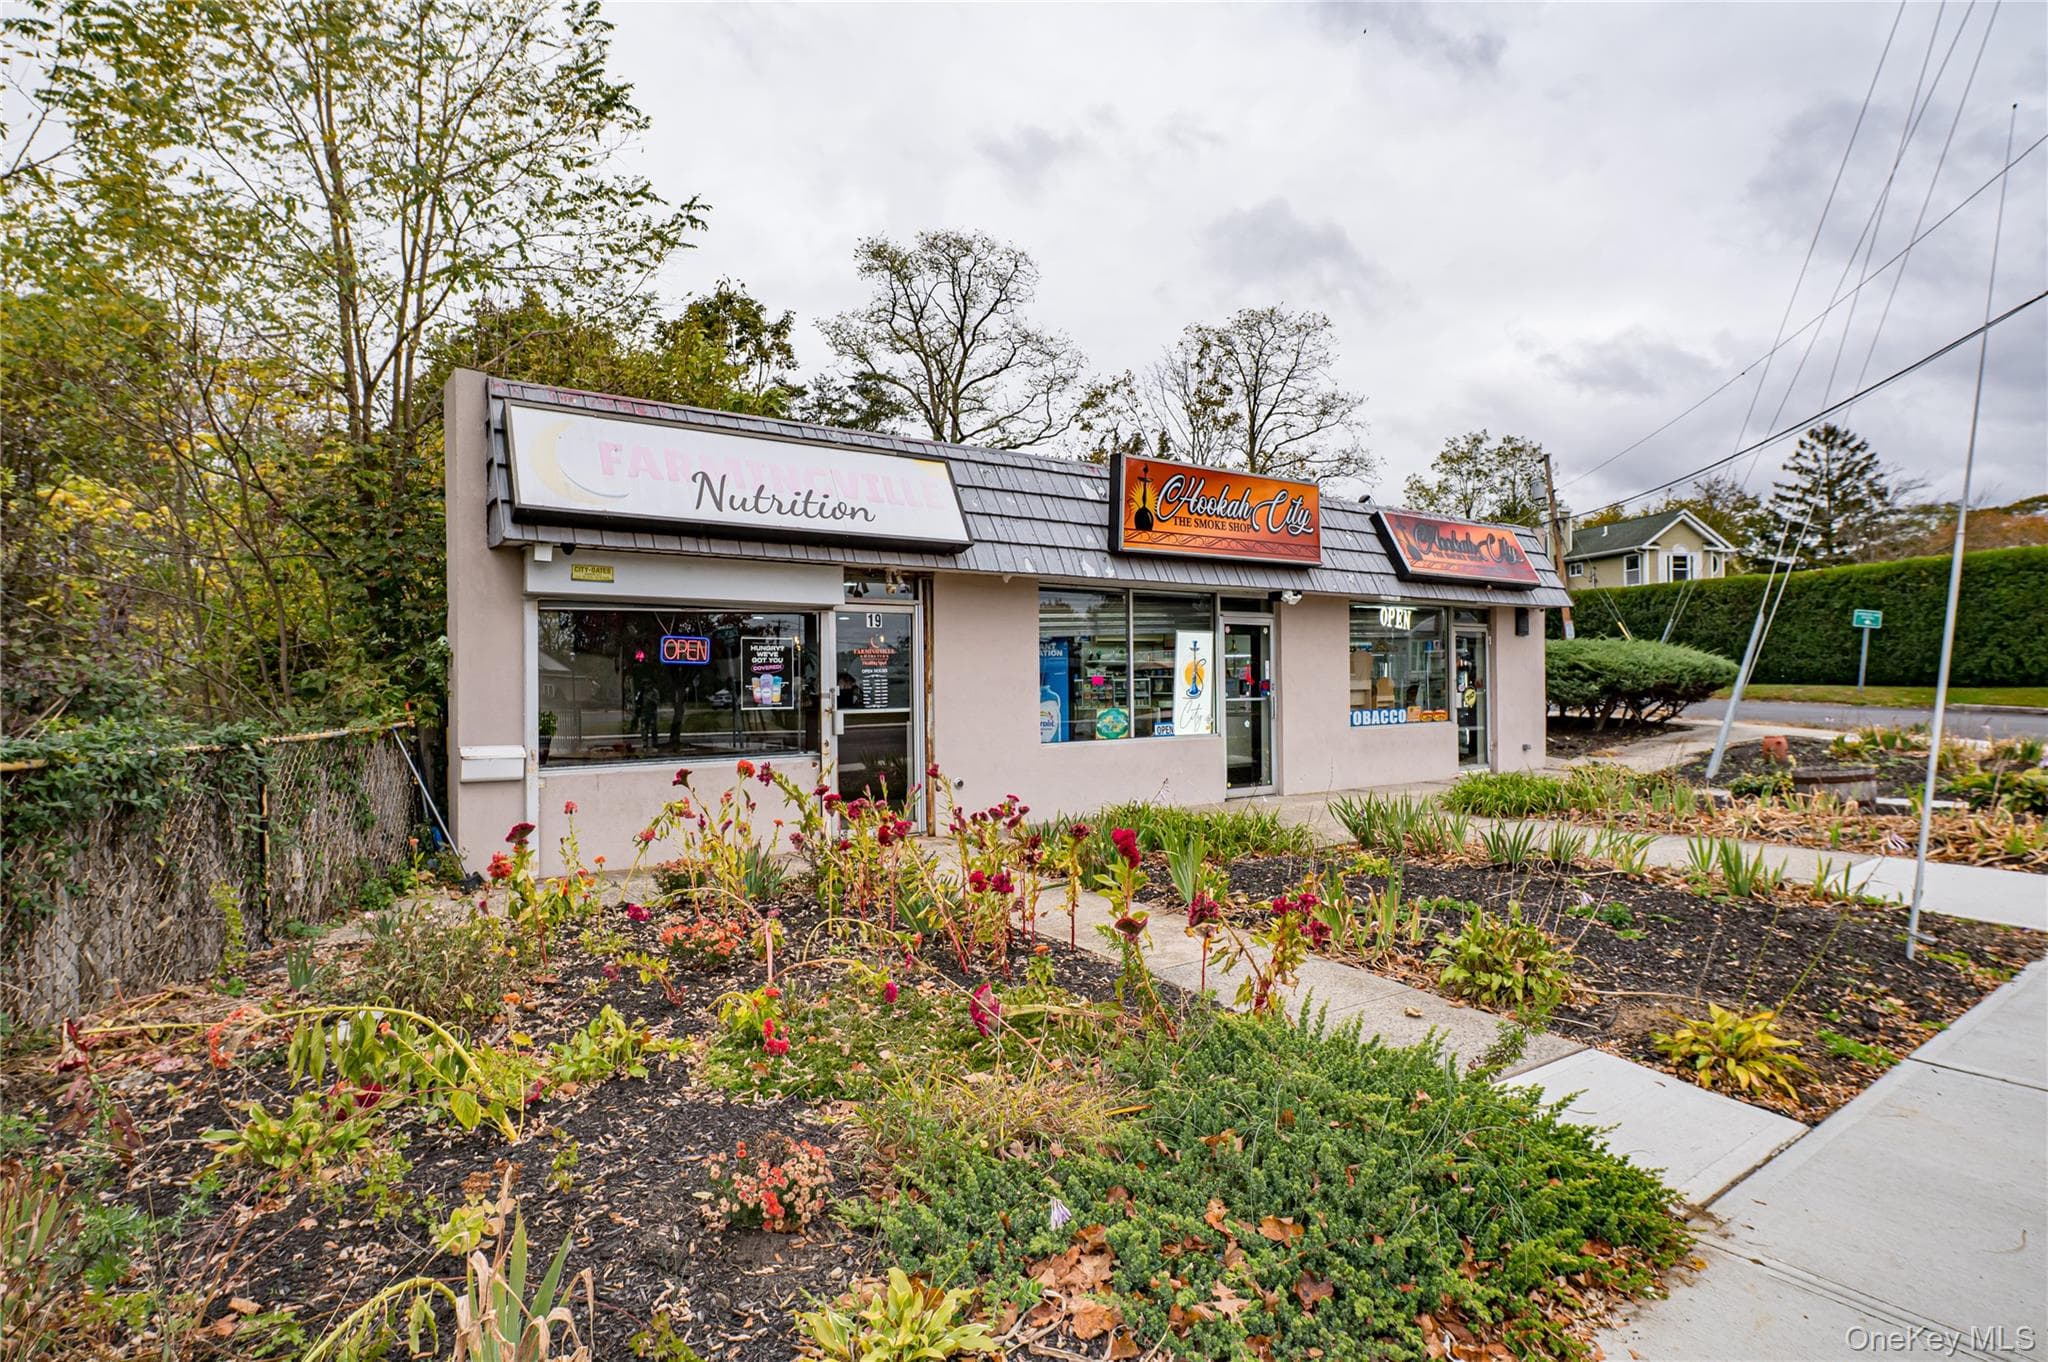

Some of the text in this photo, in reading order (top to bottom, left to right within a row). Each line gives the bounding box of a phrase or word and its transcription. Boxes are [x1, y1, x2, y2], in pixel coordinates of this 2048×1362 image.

[598, 441, 945, 510] FARMINGVILLE
[691, 470, 876, 523] Nutrition
[1156, 474, 1314, 536] Hookah City
[1173, 515, 1252, 533] THE SMOKE SHOP
[868, 613, 881, 627] 19
[1380, 606, 1412, 631] OPEN
[664, 638, 708, 661] OPEN
[1156, 725, 1174, 735] OPEN
